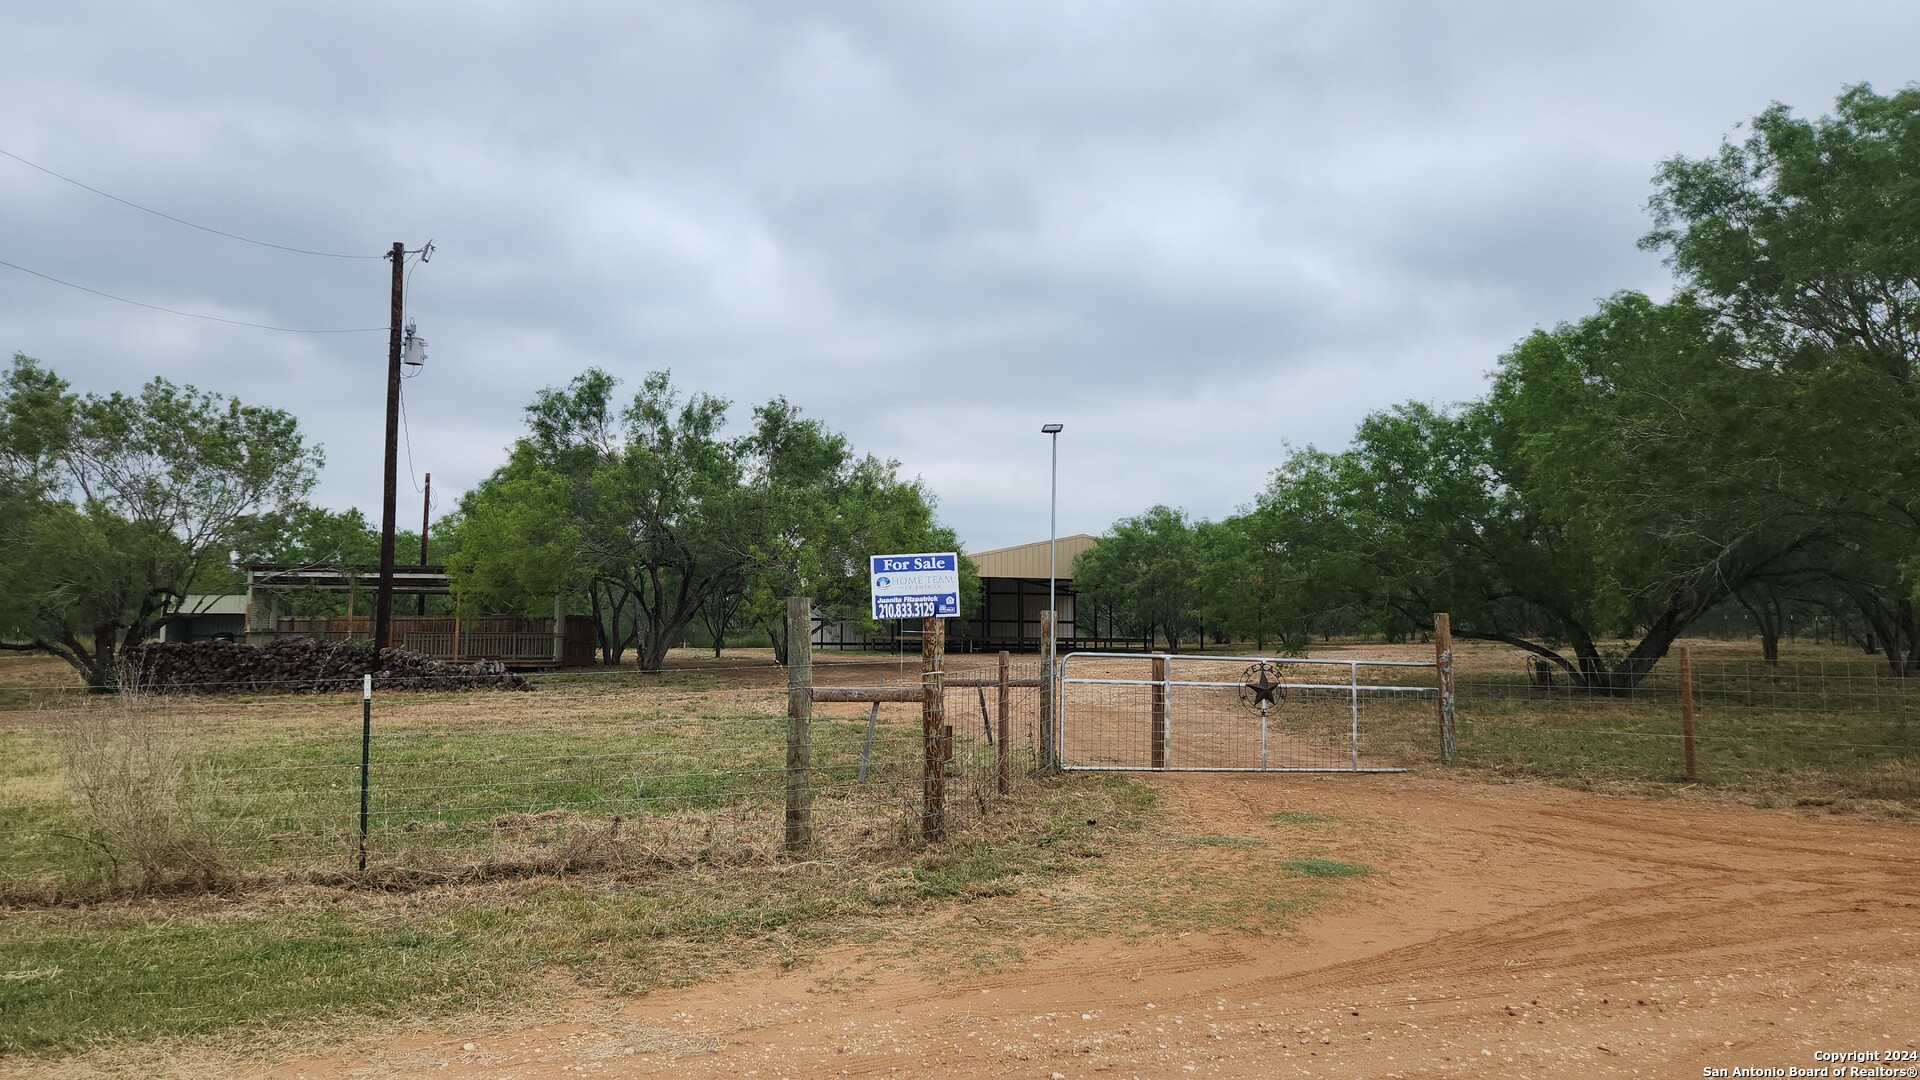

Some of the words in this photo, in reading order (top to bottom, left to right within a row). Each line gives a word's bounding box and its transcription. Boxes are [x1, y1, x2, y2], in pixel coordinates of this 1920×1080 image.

[883, 559, 910, 571] For
[914, 557, 946, 570] Sale
[891, 576, 922, 585] HOME
[925, 575, 954, 584] TEAM
[877, 596, 903, 604] Juanita
[903, 595, 939, 603] Fitzpatrick
[878, 602, 935, 619] 210.833.3129
[1243, 663, 1282, 678] TEXAS
